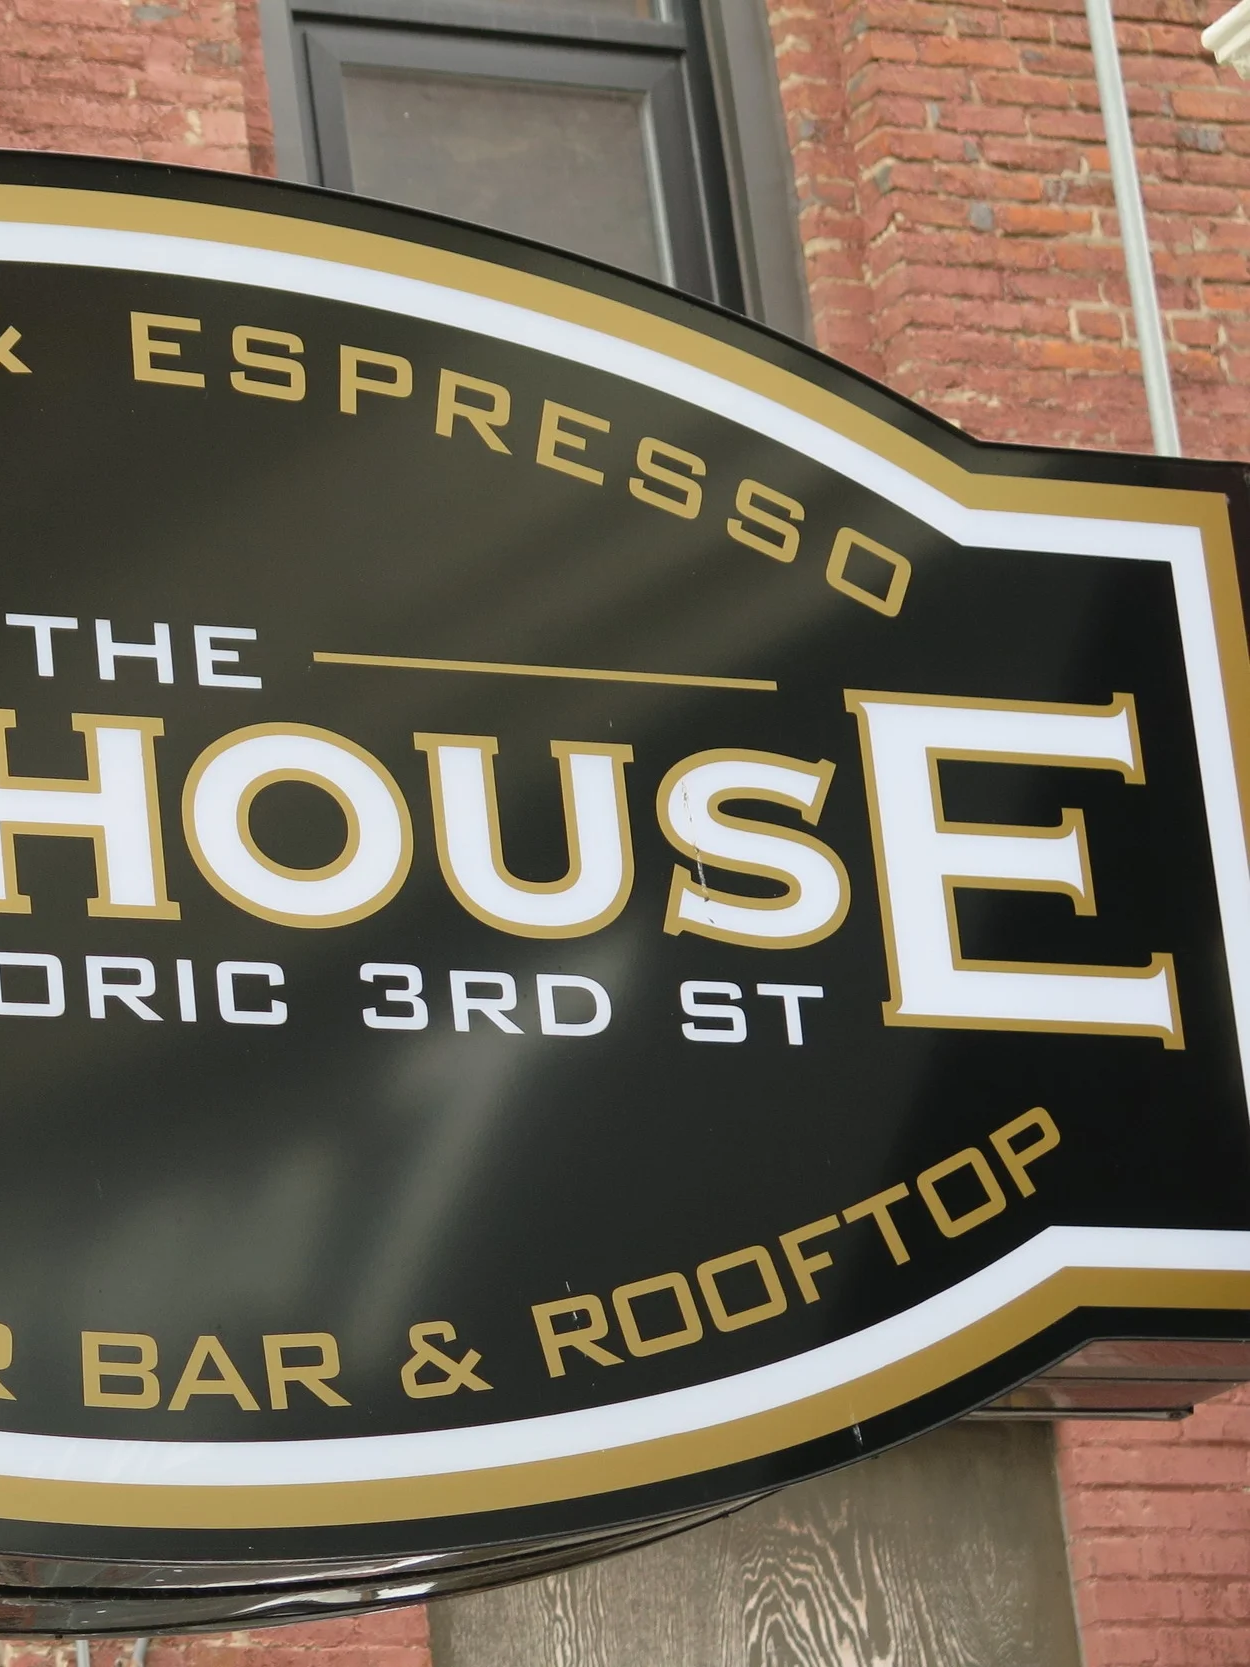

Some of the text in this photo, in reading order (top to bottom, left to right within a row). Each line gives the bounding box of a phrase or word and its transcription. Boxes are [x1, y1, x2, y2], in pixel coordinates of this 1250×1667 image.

[131, 312, 911, 616] ESPRESSO
[6, 614, 262, 689] THE
[360, 963, 611, 1036] 3RD
[680, 981, 823, 1045] ST
[81, 1331, 351, 1410] BAR
[401, 1321, 493, 1398] &
[532, 1107, 1060, 1377] ROOFTOP
